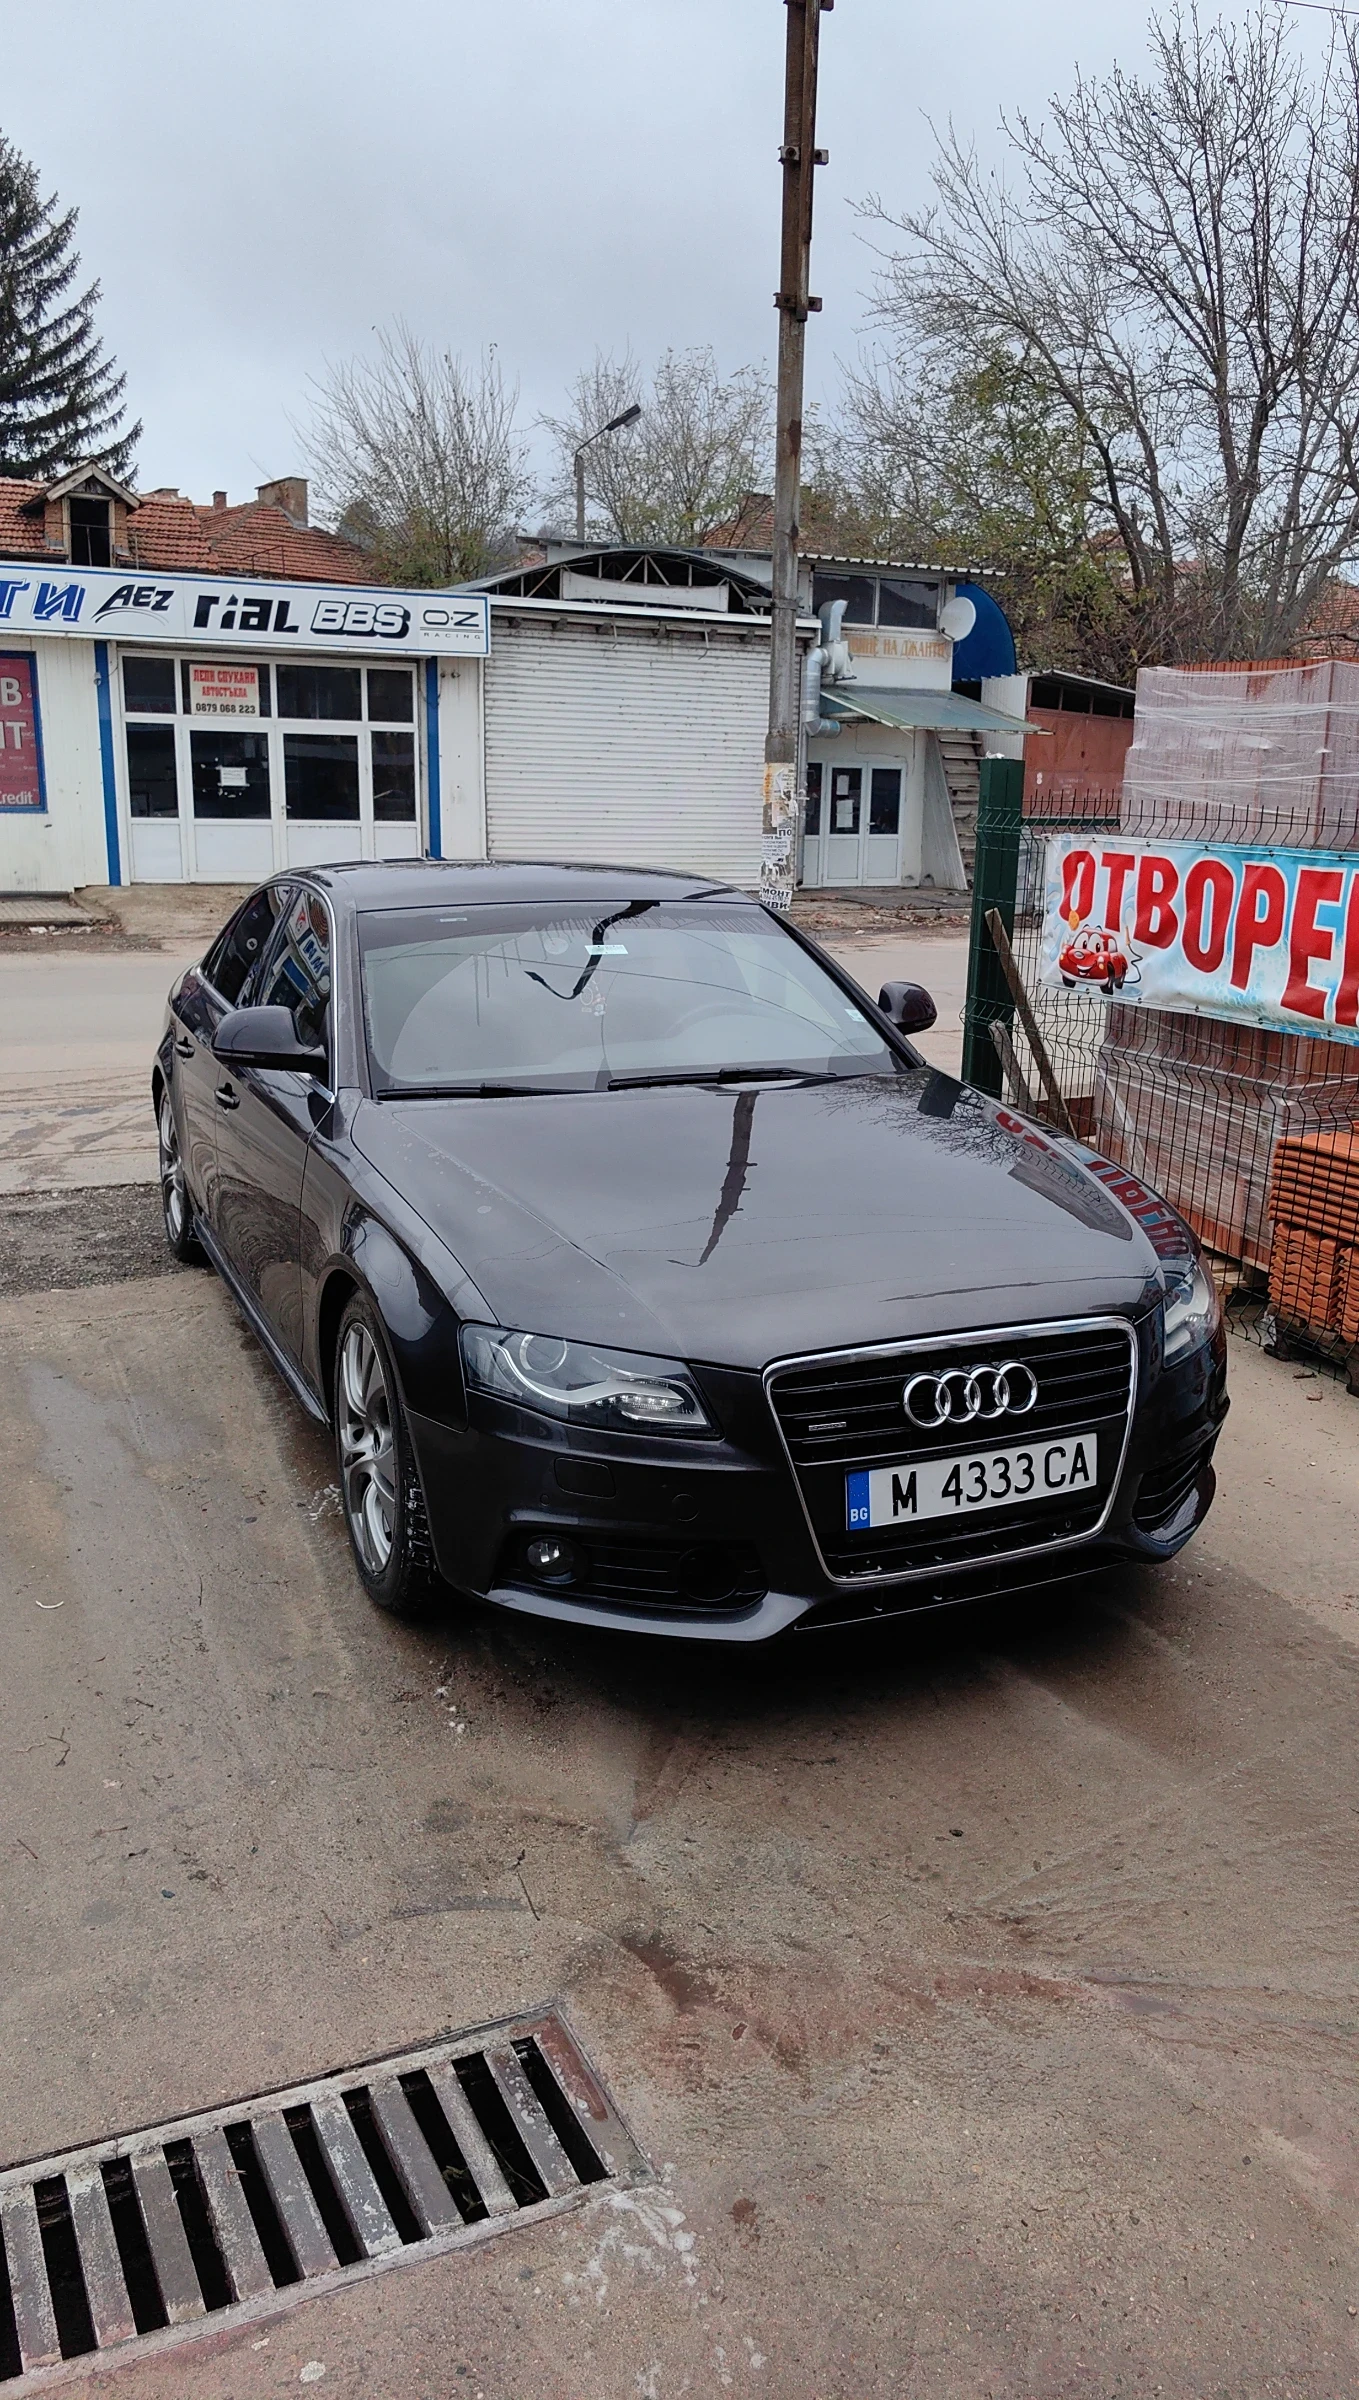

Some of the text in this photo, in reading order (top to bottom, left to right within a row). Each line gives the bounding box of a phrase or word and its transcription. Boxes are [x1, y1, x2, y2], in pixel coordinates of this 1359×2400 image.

[310, 600, 411, 639] BBS
[423, 632, 481, 640] RACING
[883, 638, 897, 656] НА
[217, 670, 256, 684] СПУКАНИ
[202, 685, 248, 698] АВТОСТЪКЛА
[195, 702, 256, 715] 0879 068 223
[760, 887, 790, 898] МОНТ
[891, 1470, 918, 1517] M
[940, 1452, 1036, 1507] 4333
[850, 1507, 868, 1523] BG
